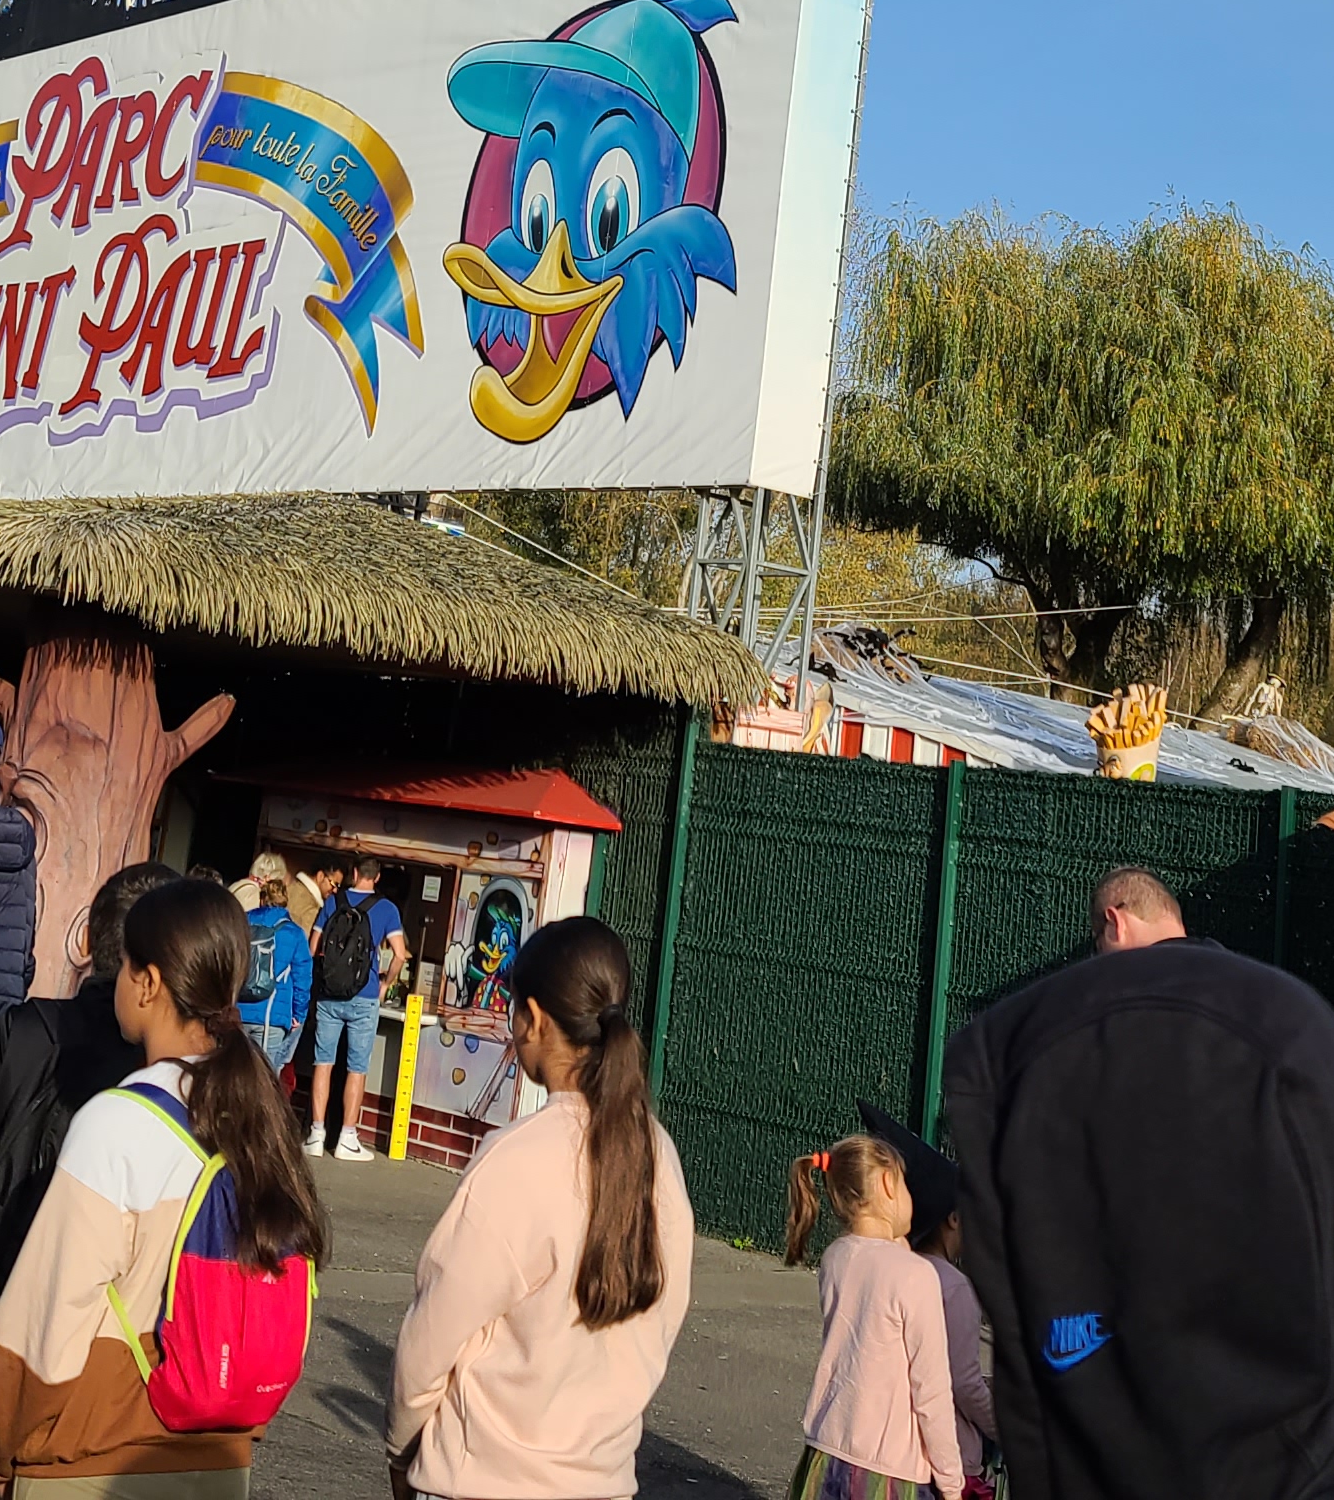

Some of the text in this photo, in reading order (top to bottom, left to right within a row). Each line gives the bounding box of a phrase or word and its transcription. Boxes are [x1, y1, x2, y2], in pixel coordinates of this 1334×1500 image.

[199, 122, 380, 251] pour toute la Famille
[58, 213, 267, 416] PAUL
[1050, 1312, 1107, 1354] NIKE
